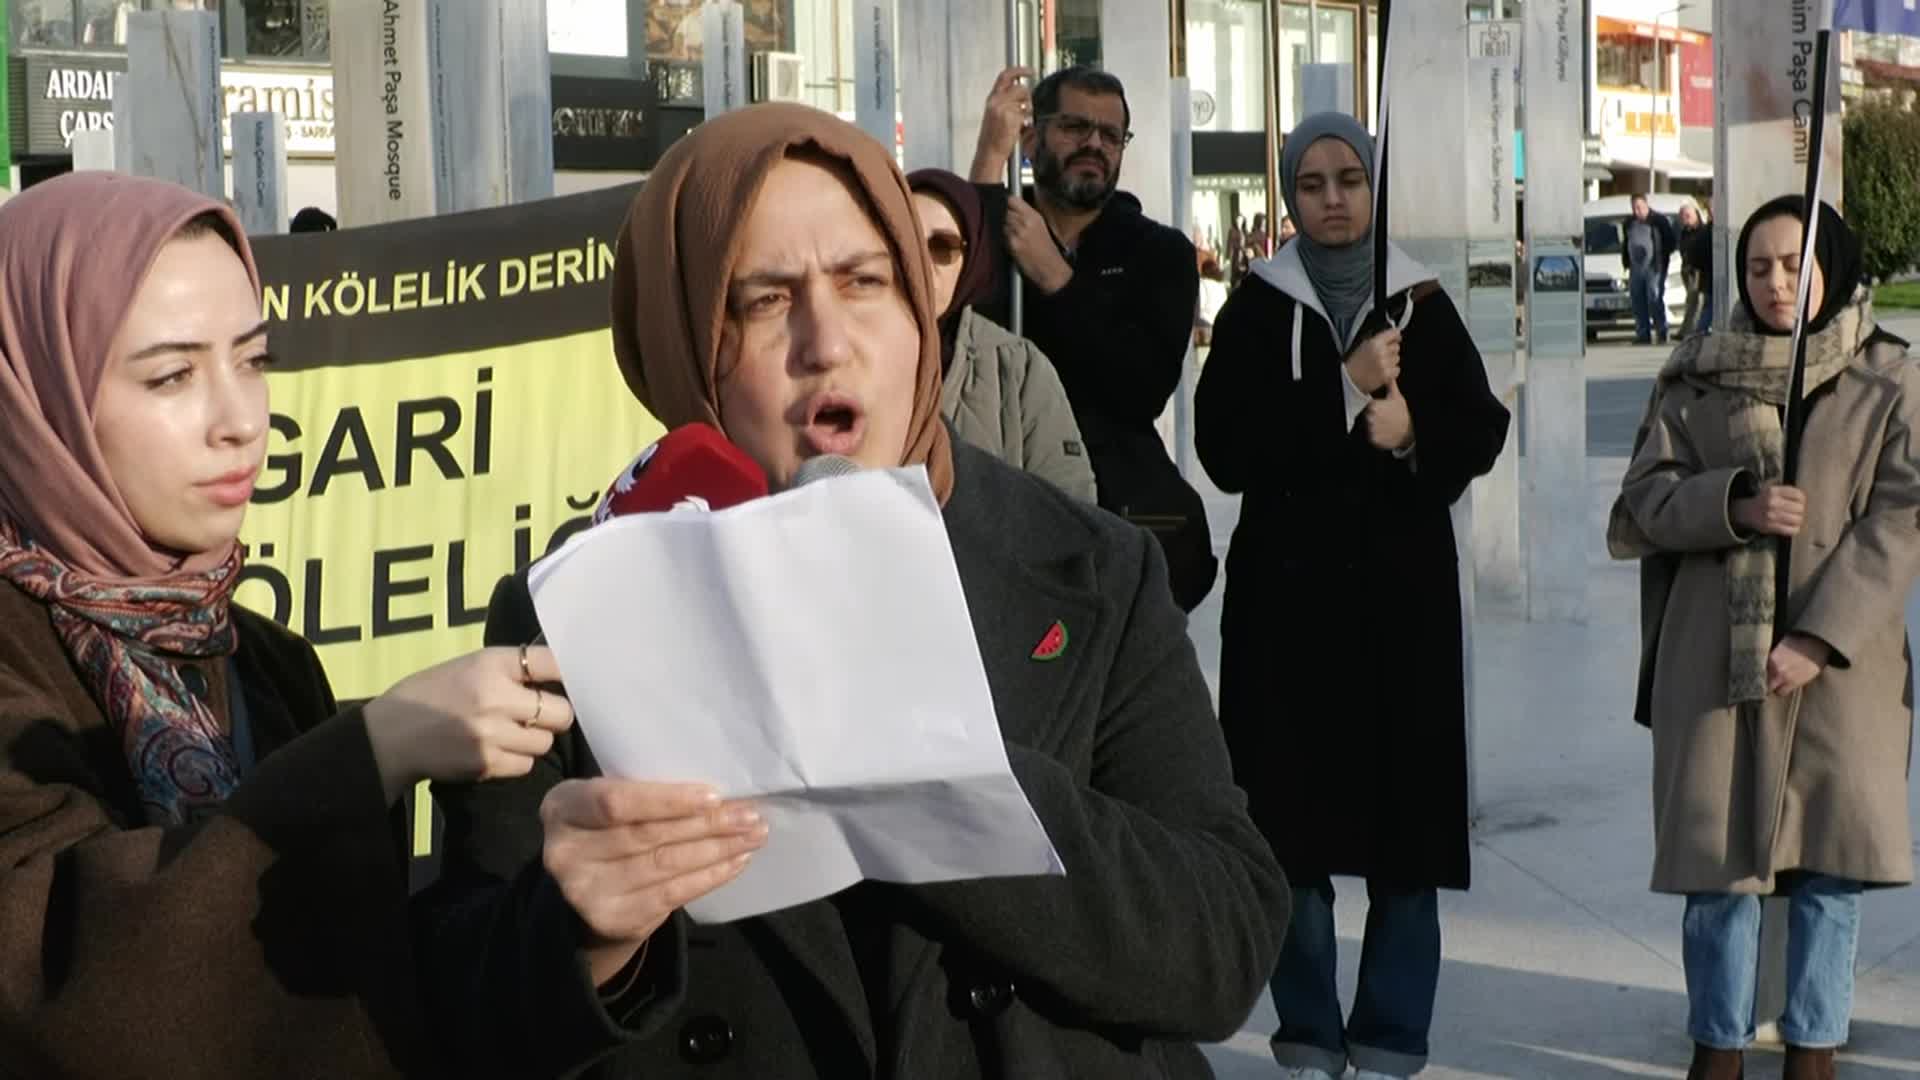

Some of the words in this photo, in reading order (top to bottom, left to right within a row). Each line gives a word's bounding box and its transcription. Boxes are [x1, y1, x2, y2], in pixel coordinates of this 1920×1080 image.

[383, 0, 401, 66] Ahmet
[381, 71, 402, 115] Paşa
[1786, 41, 1812, 92] Paşa
[384, 120, 403, 201] Mosque
[304, 260, 487, 319] KÖLELİK
[250, 366, 493, 505] GARİ
